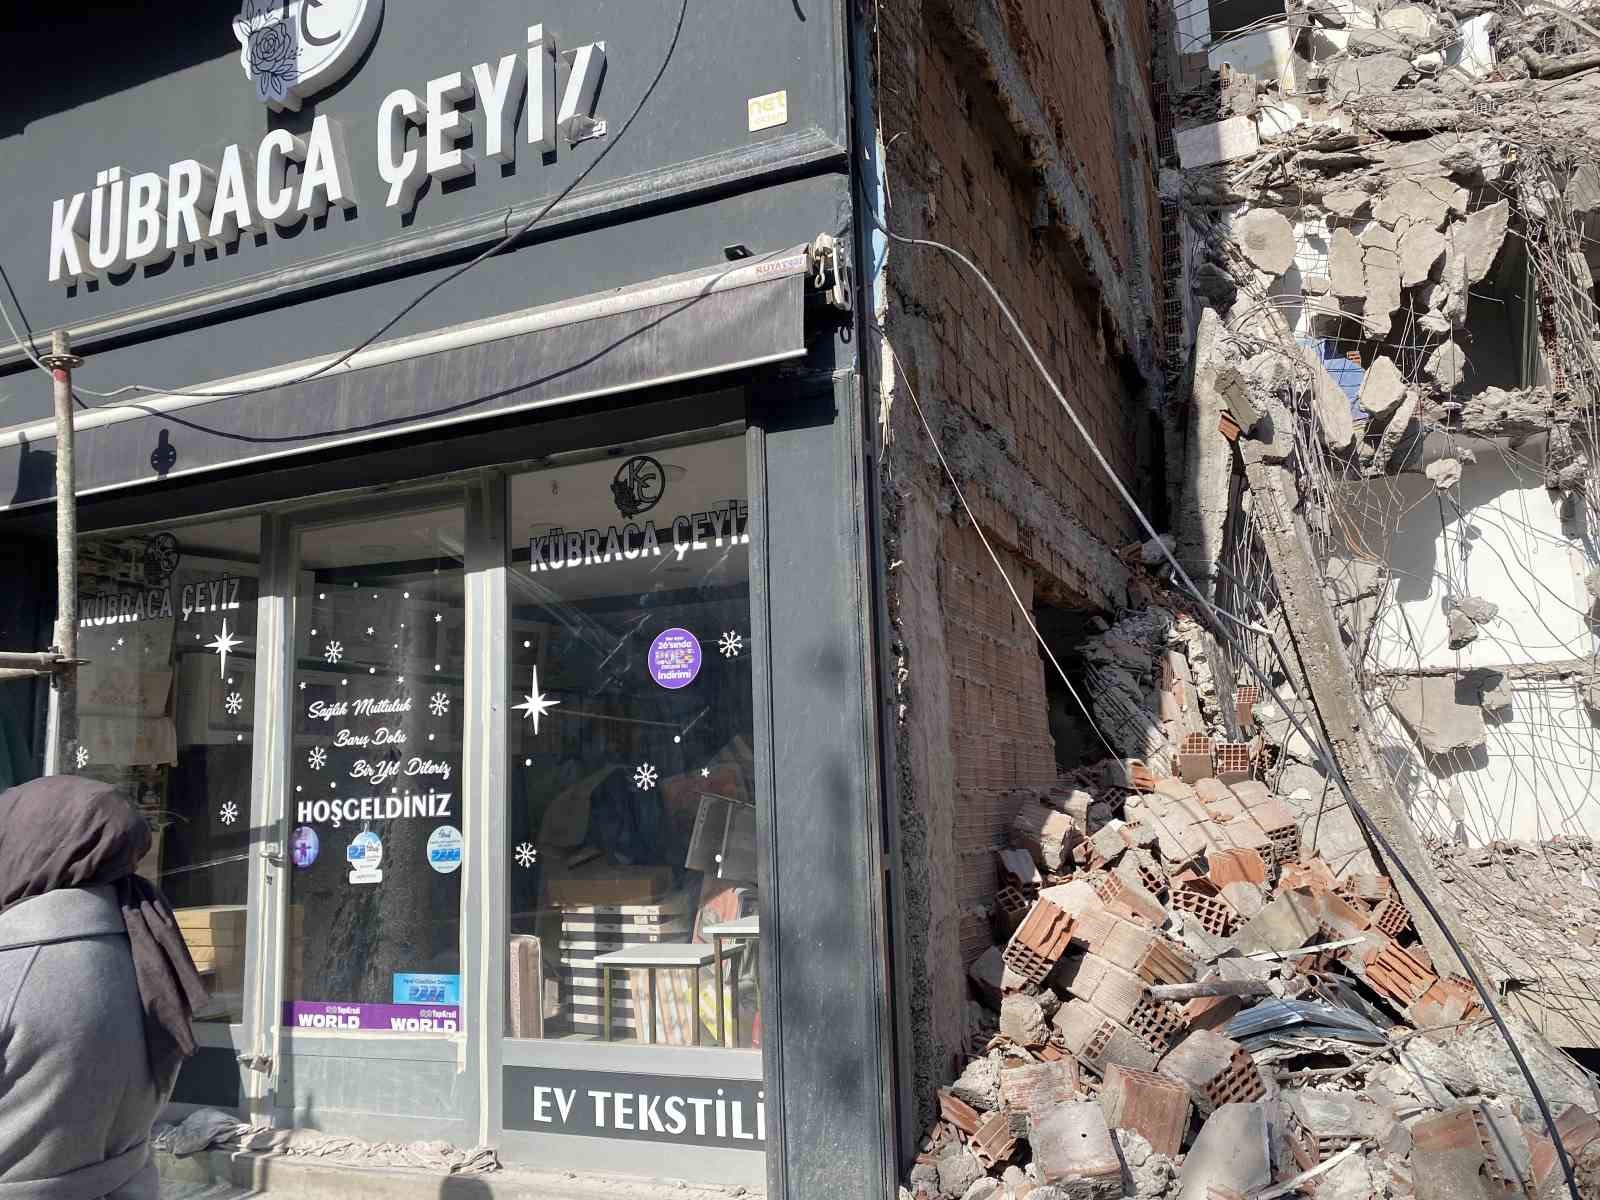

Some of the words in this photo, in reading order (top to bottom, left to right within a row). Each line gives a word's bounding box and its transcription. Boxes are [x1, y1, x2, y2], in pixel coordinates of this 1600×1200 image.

[48, 114, 346, 284] KÜBRACA
[376, 23, 606, 207] ÇEYİZ
[529, 520, 661, 572] KÜBRACA
[79, 588, 173, 628] KÜBRACA
[181, 574, 240, 622] ÇEYİZ
[308, 700, 348, 722] Sağlık
[351, 698, 412, 717] Mutluluk
[333, 728, 370, 749] Barış
[371, 727, 407, 746] Dolu
[349, 759, 376, 778] Bir
[369, 759, 400, 785] Yıl
[404, 757, 452, 780] Dileriz
[297, 789, 453, 828] HOŞGELDİNİZ
[298, 1013, 361, 1029] WORLD
[390, 1017, 457, 1033] WORLD
[533, 1085, 577, 1125] EV
[587, 1087, 766, 1141] TEKSTİLİ
